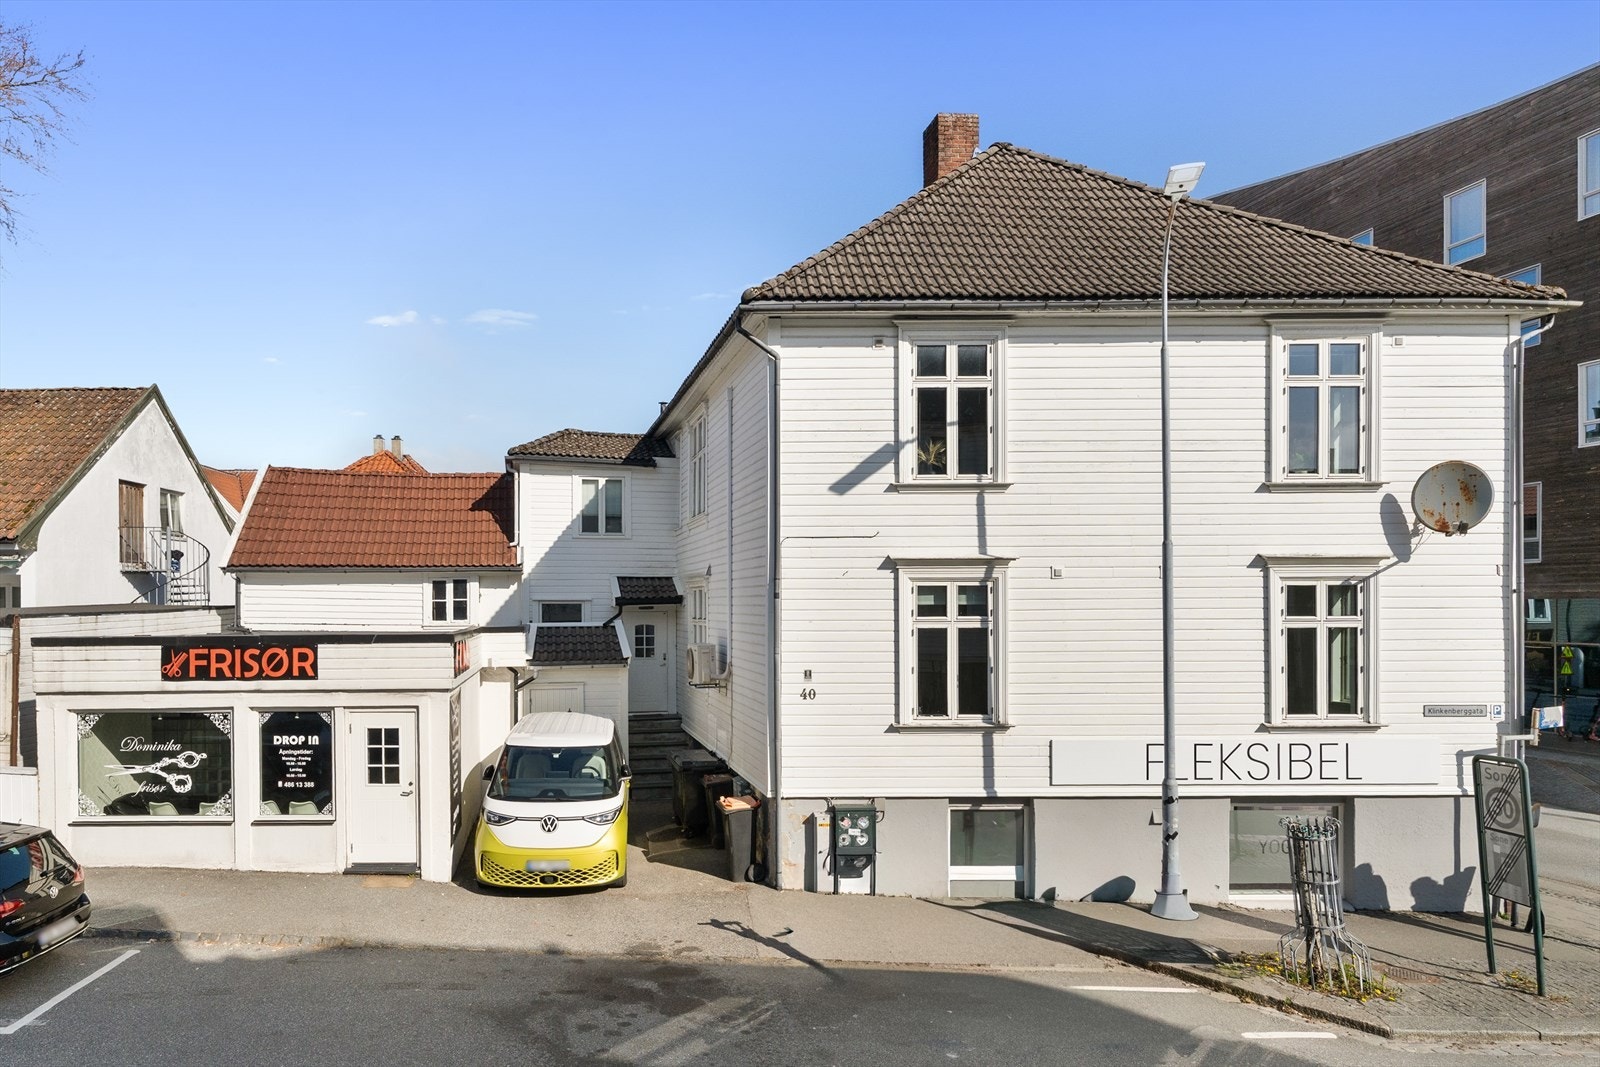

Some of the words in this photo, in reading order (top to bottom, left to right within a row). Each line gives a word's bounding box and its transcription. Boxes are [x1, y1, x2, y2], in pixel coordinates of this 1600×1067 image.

[188, 647, 315, 678] FRISØR
[800, 688, 816, 701] 40
[1427, 705, 1484, 716] Klinkenberggata
[120, 736, 183, 752] Dominika
[273, 735, 305, 746] DROP
[131, 780, 167, 798] frisør
